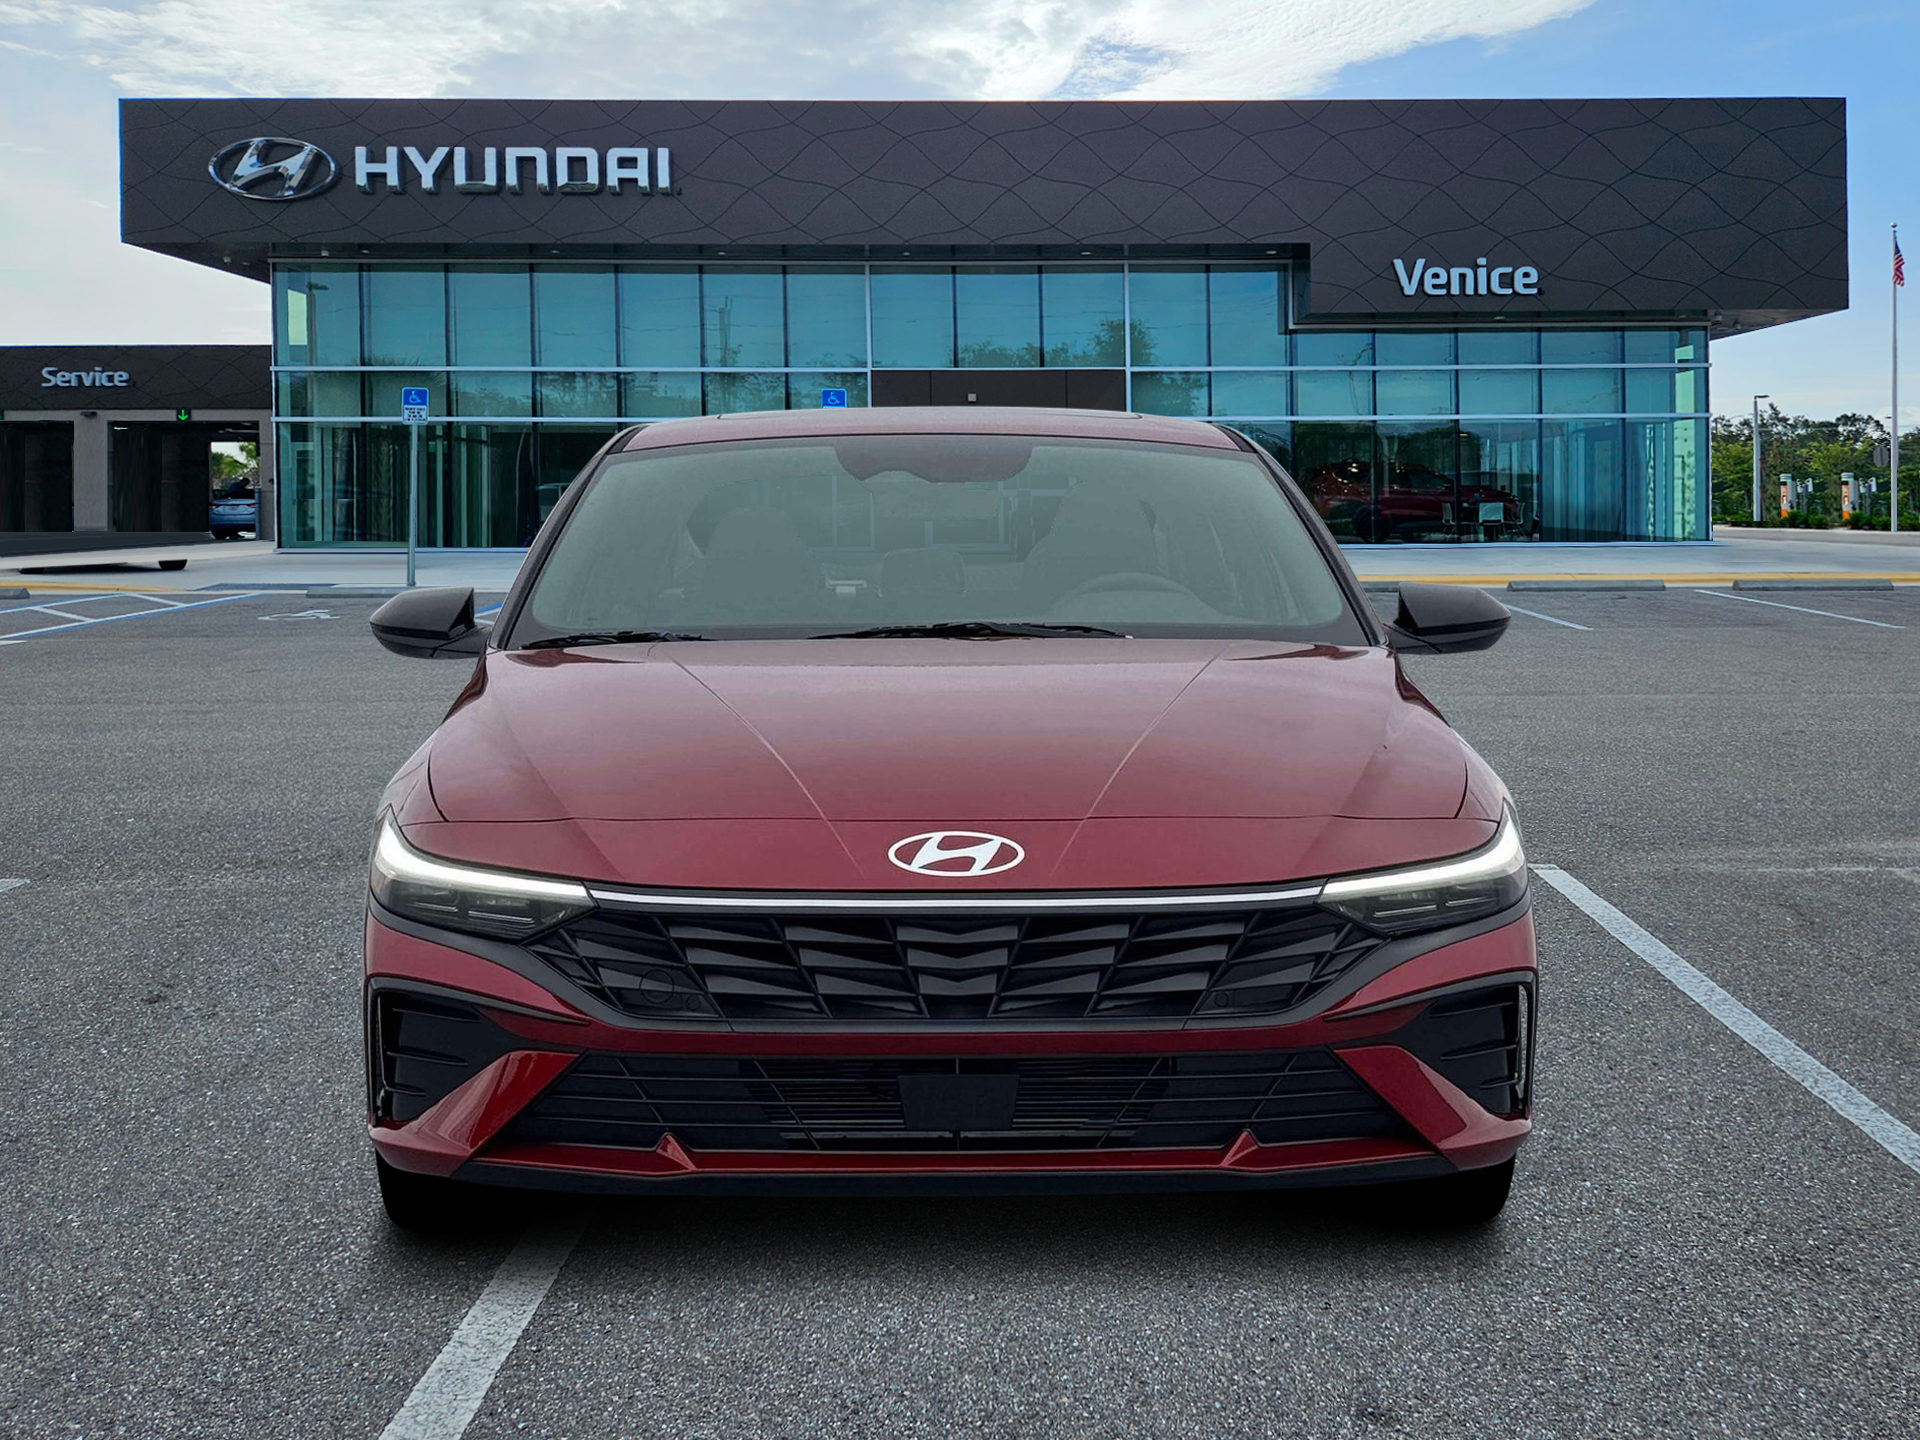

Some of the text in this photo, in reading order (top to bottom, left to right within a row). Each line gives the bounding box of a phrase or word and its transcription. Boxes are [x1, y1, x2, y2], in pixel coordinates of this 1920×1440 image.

[354, 146, 671, 193] HYUNDAI
[1393, 257, 1539, 296] Venice
[41, 366, 130, 387] Service
